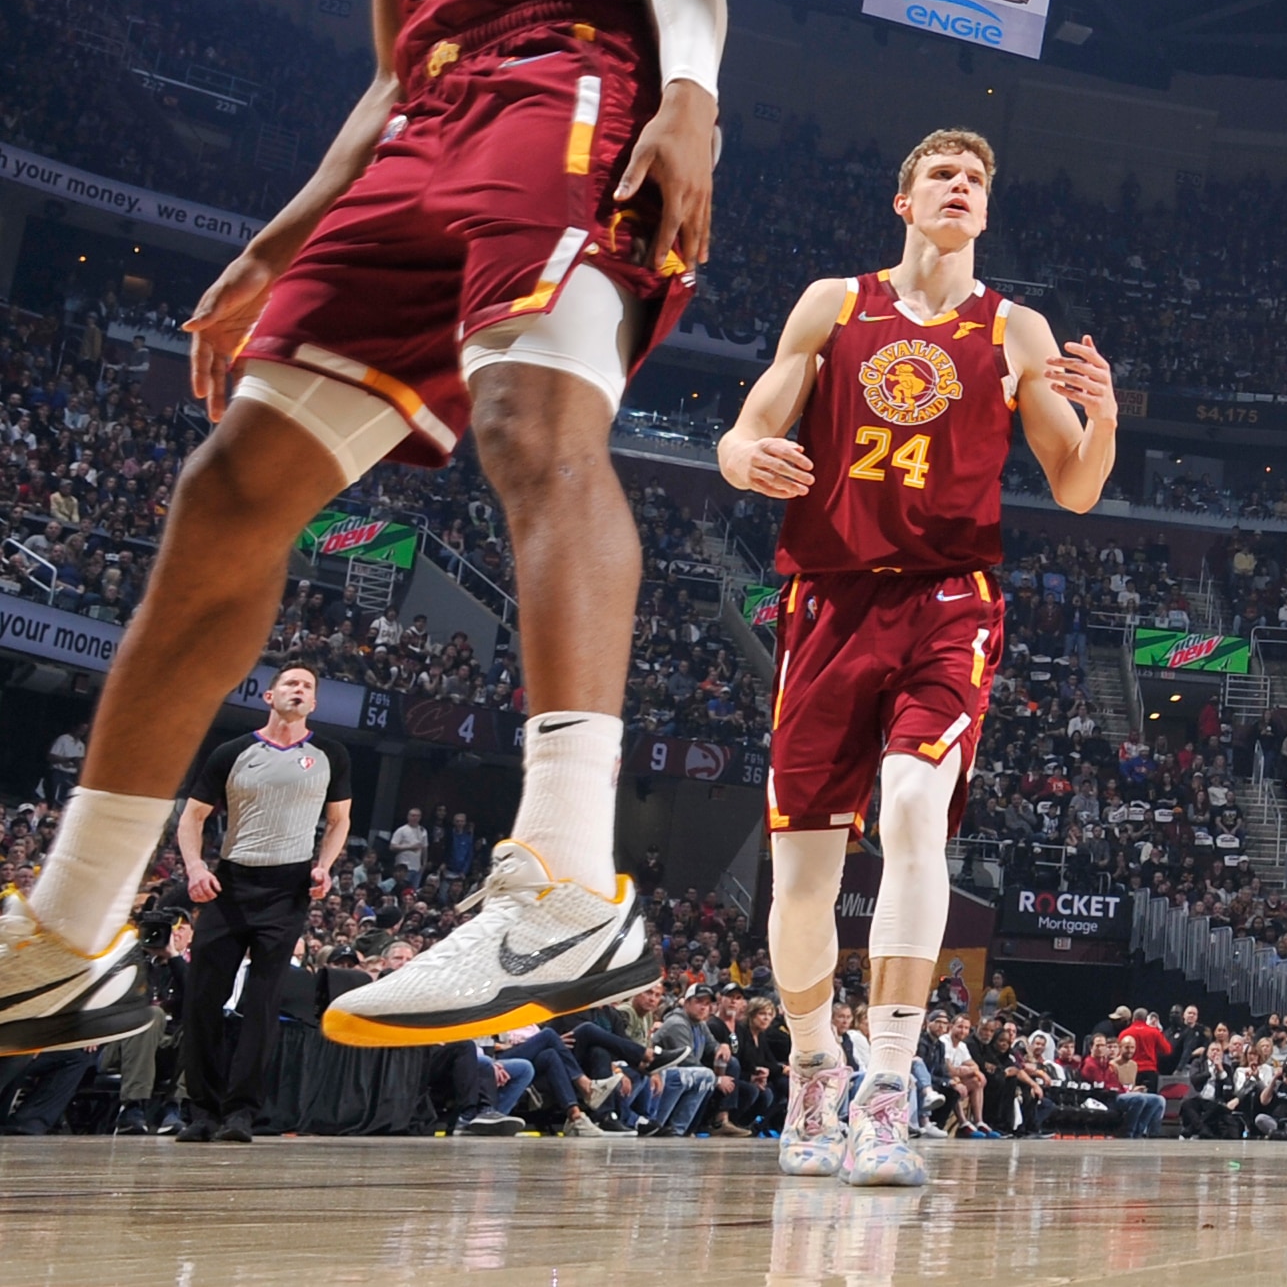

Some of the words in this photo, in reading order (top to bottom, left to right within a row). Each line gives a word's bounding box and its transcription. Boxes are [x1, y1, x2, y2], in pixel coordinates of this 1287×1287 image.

[12, 158, 63, 186] your
[66, 175, 143, 212] money.
[157, 202, 188, 223] we
[194, 214, 233, 236] can
[859, 339, 963, 400] CAVALIERS
[863, 387, 950, 425] CLEVELAND
[848, 425, 932, 489] 24
[366, 708, 388, 729] 54
[457, 712, 475, 744] 4
[650, 742, 668, 771] 9
[742, 765, 763, 784] 36
[1018, 890, 1121, 919] ROCKET
[1038, 915, 1098, 935] Mortgage
